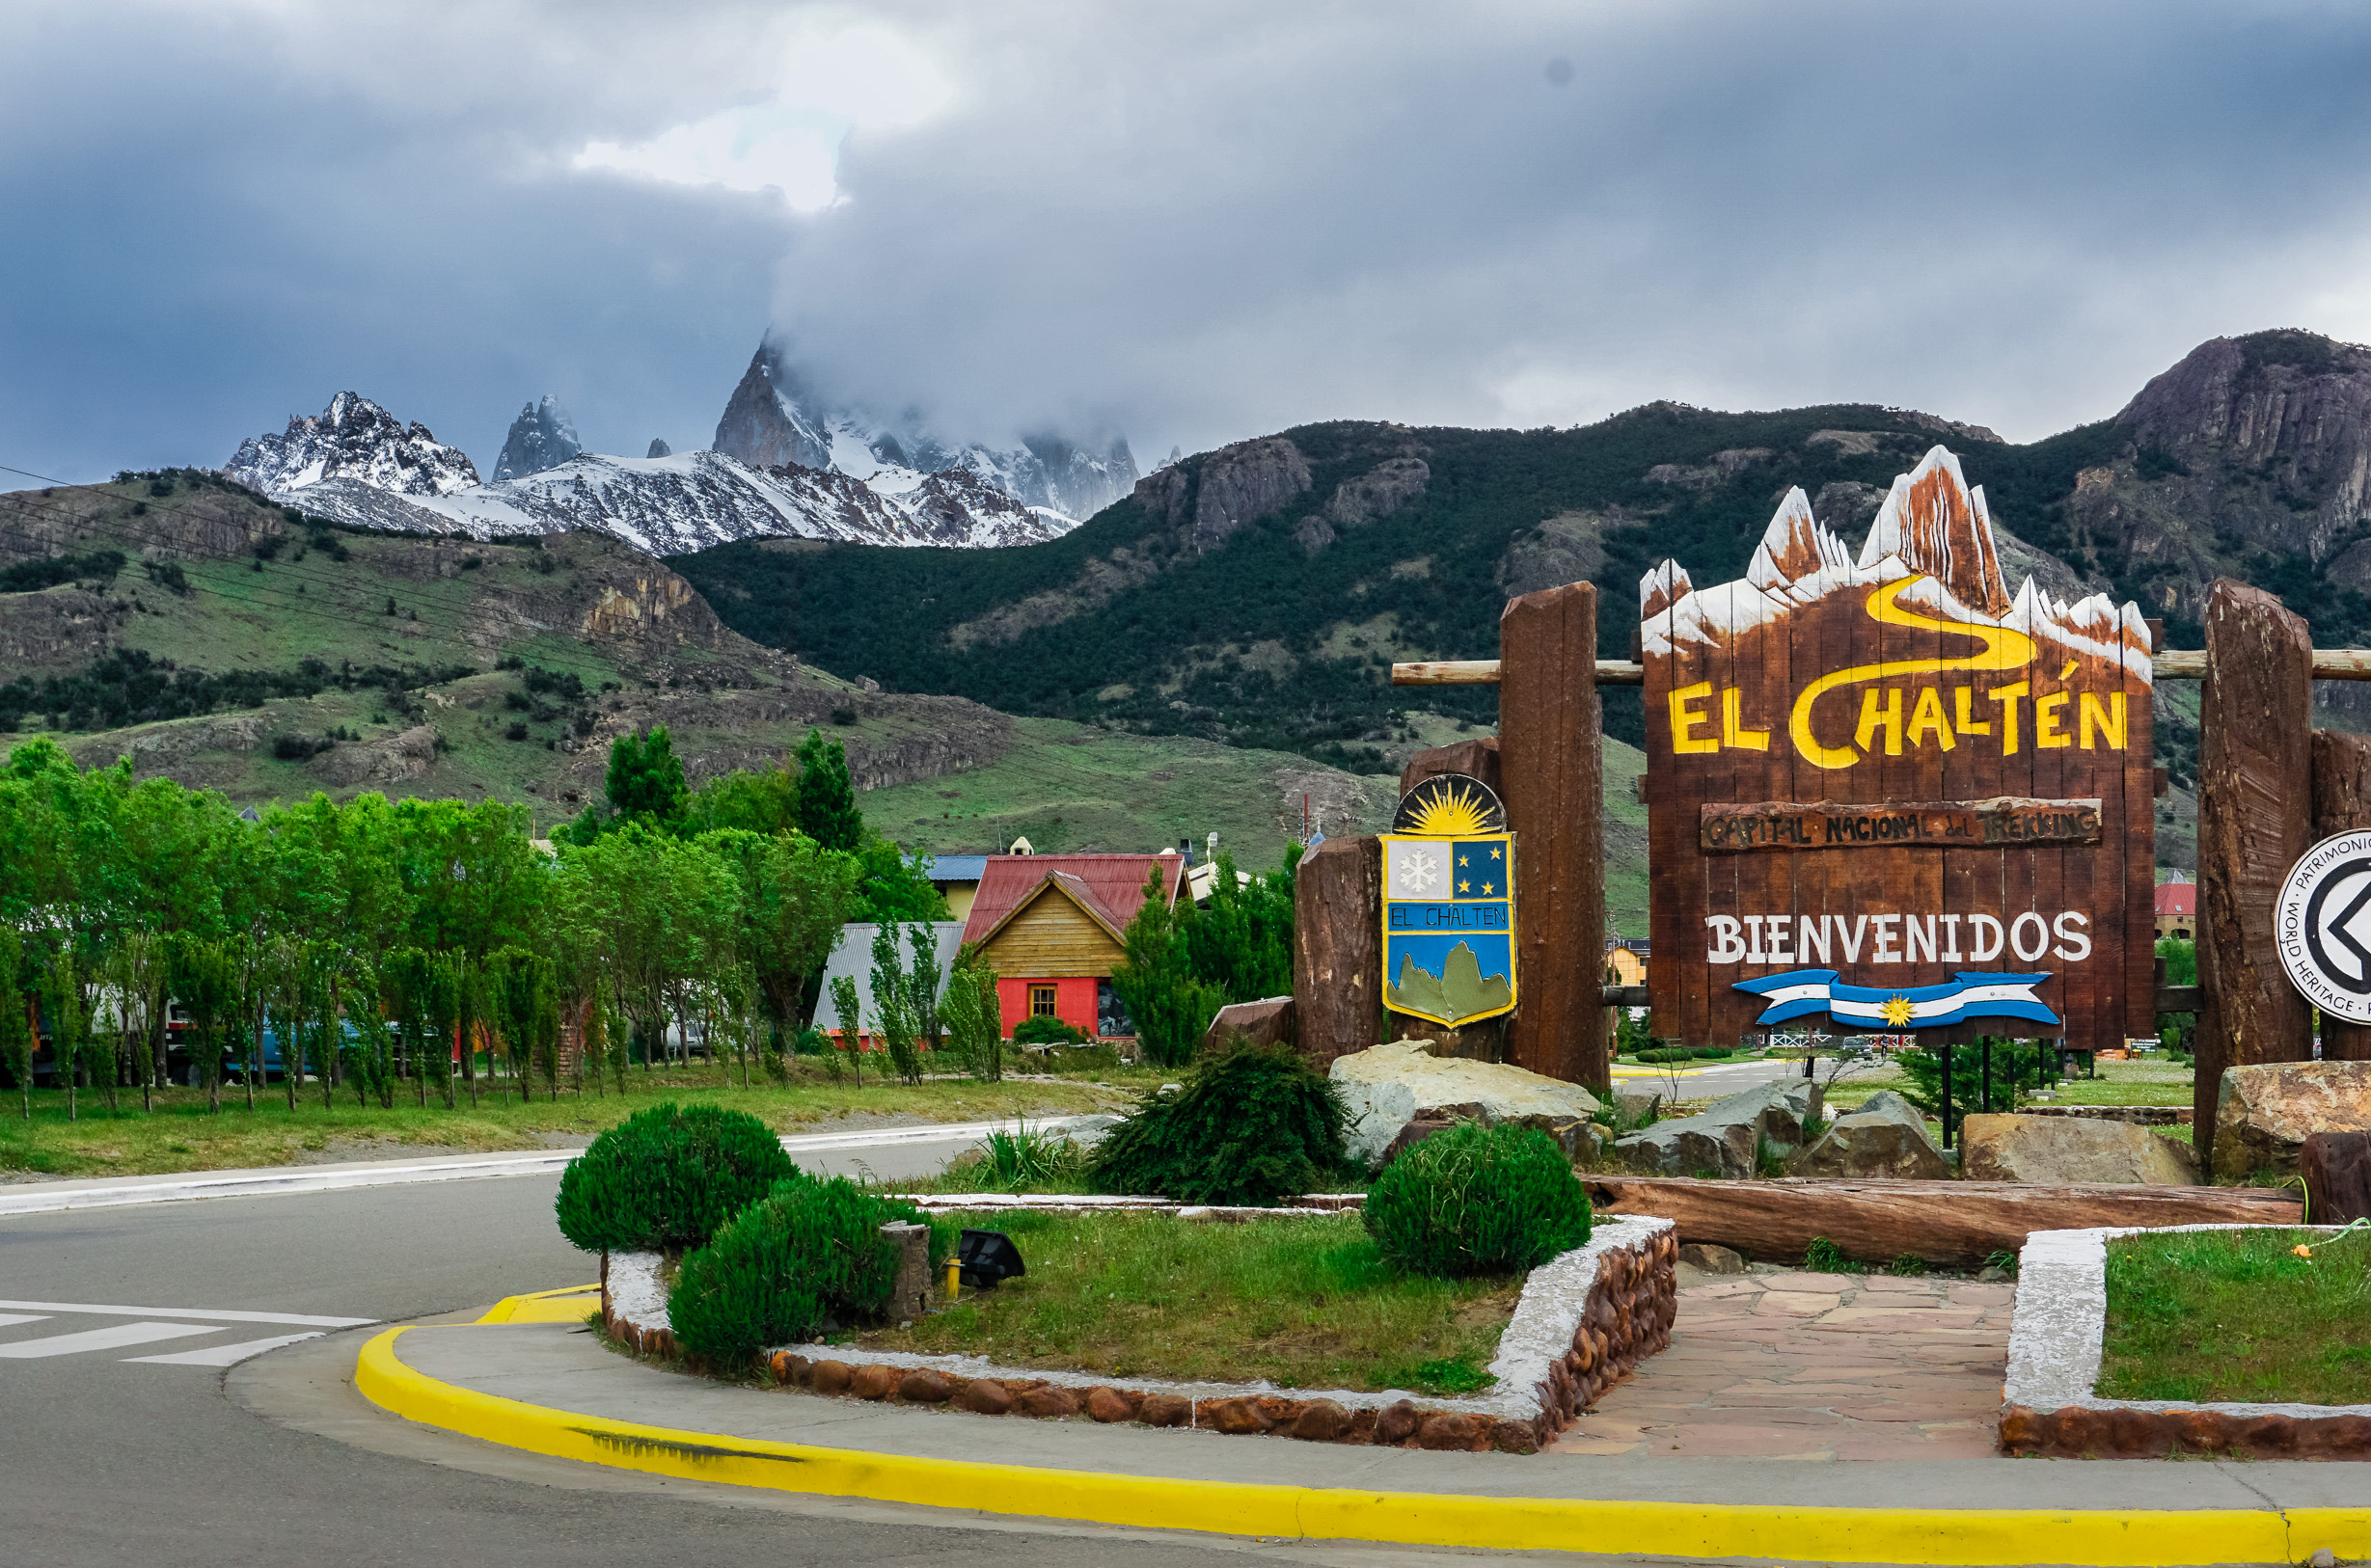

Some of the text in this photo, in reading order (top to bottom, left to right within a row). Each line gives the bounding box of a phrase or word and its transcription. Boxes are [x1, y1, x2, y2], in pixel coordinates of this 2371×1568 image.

[1667, 660, 2128, 770] EL CHALTÉN
[1703, 811, 2097, 847] CAPITAL NACIONAL del TREKKING
[2296, 838, 2371, 890] PATRIMONI
[1391, 906, 1507, 927] EL CHALTEN
[1704, 911, 2092, 964] BIENVENIDOS
[2285, 902, 2355, 1013] WORLD HERITAGE
